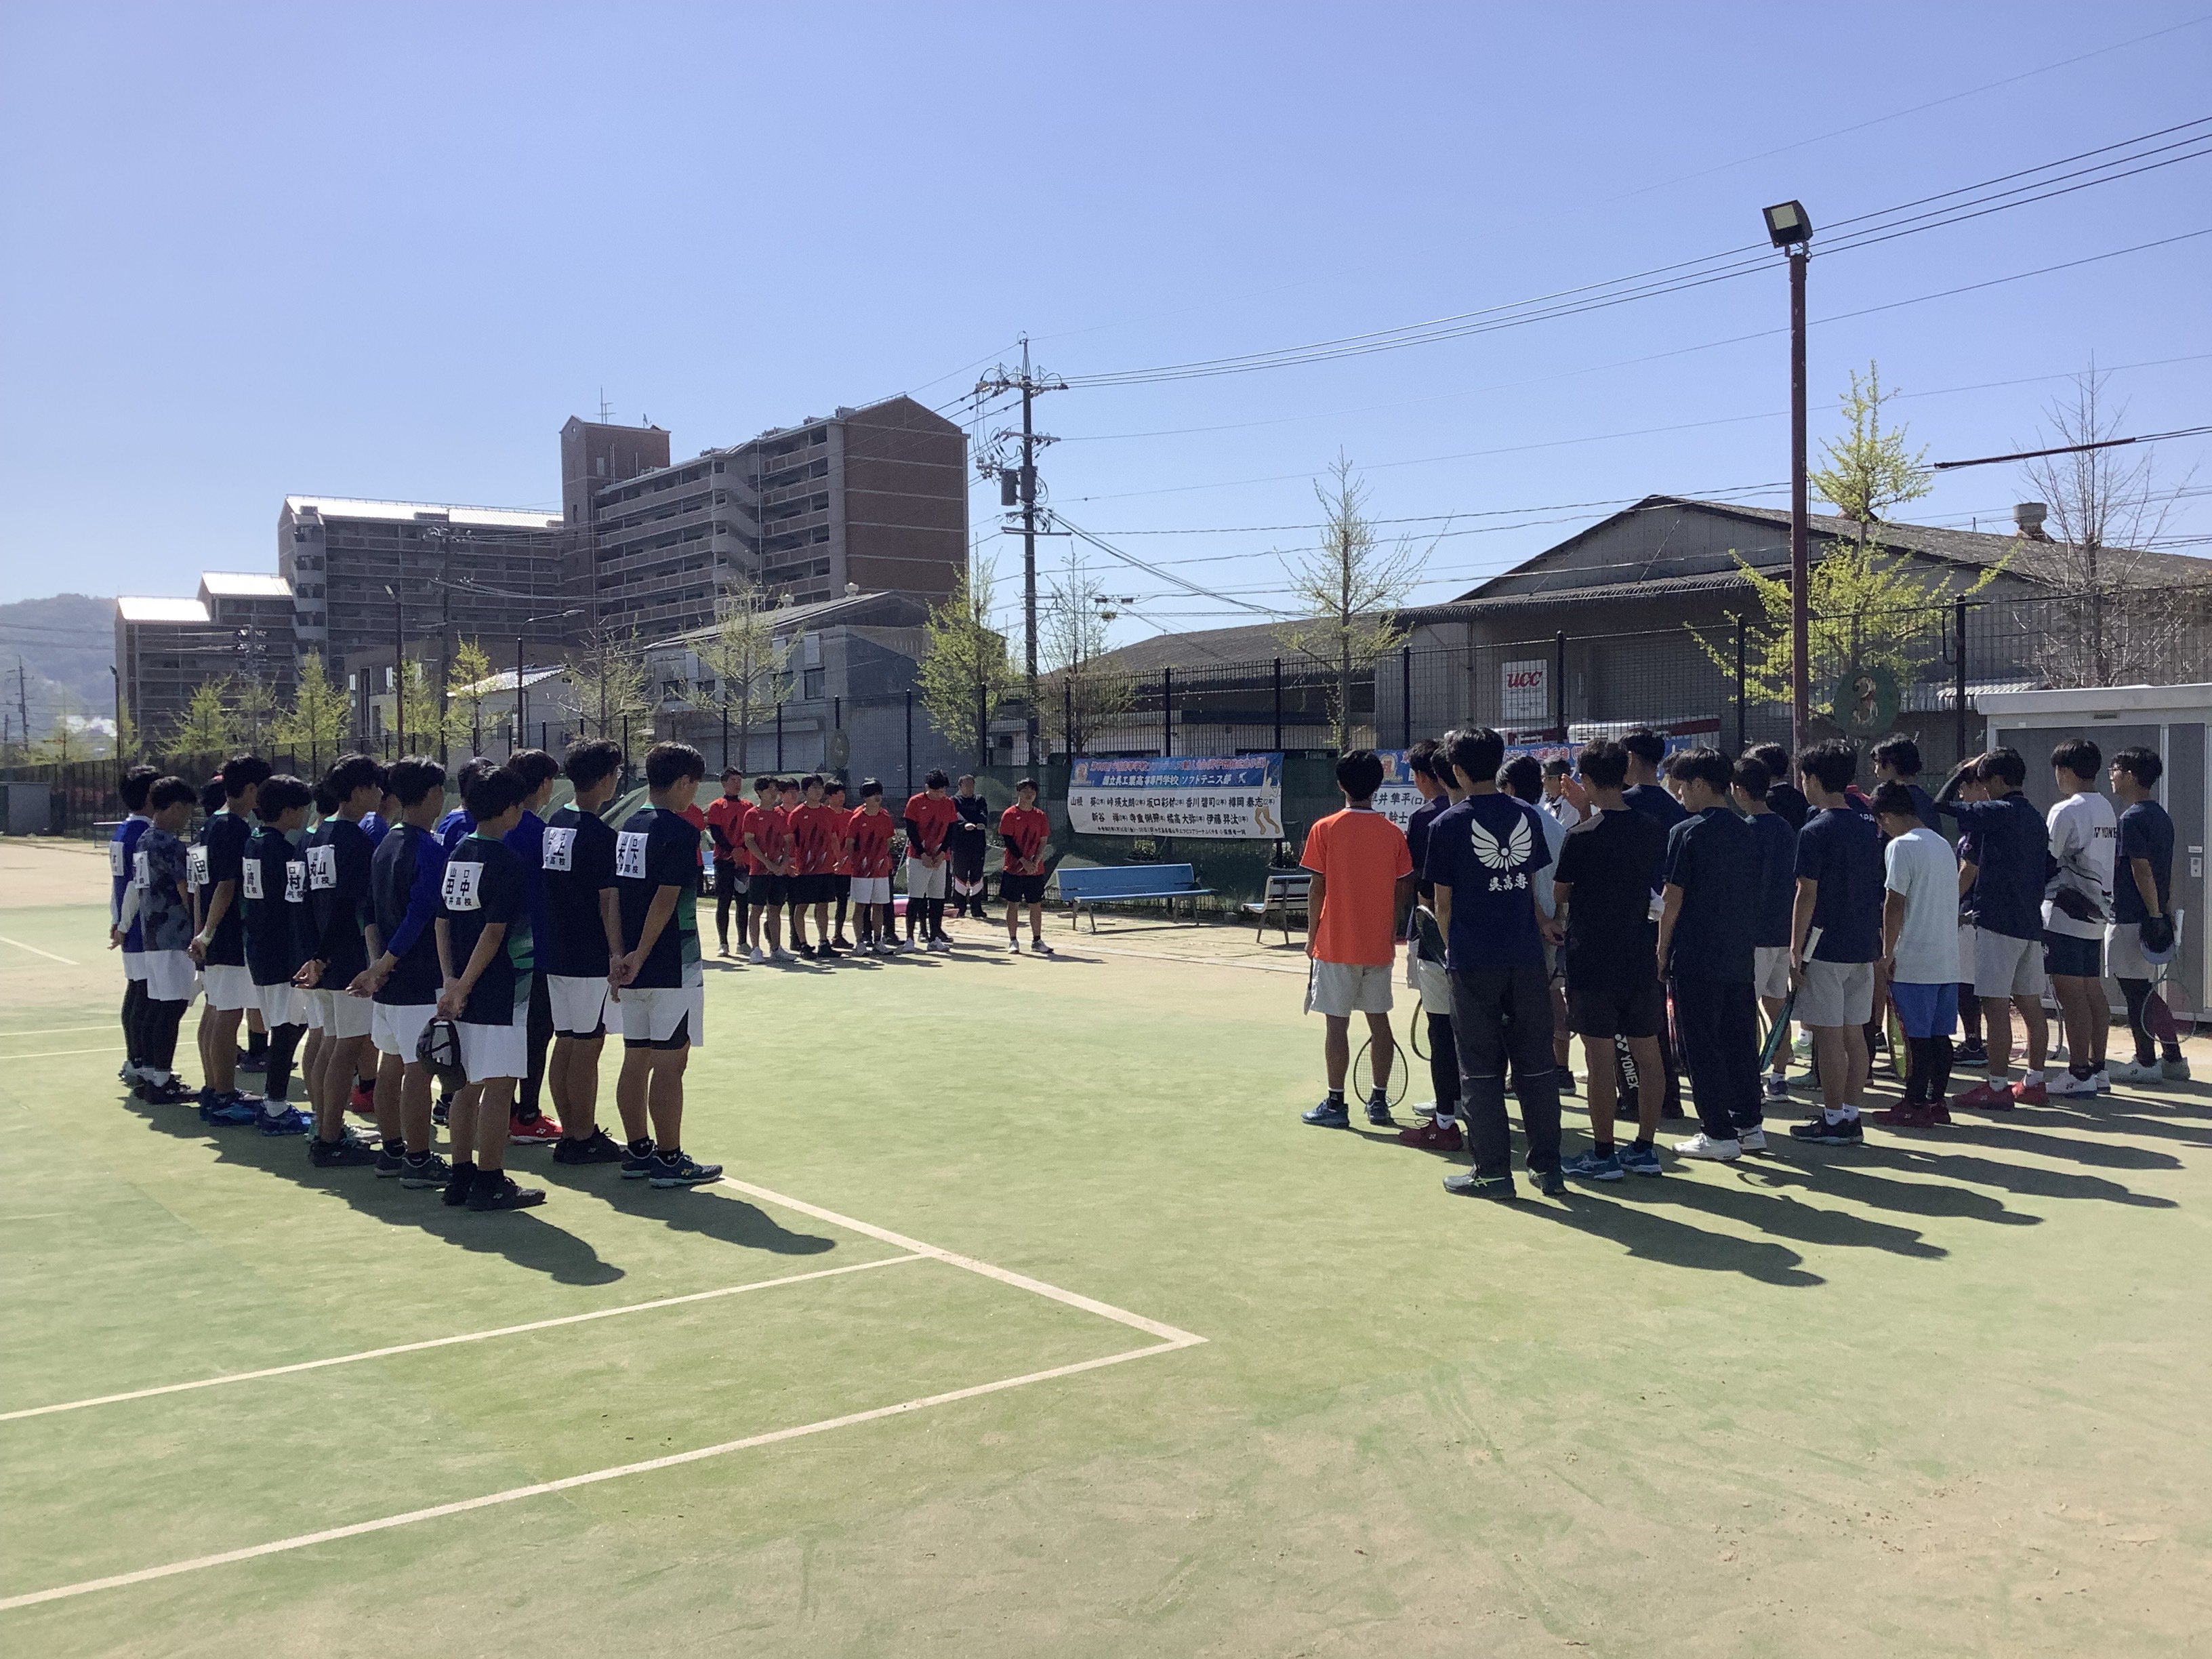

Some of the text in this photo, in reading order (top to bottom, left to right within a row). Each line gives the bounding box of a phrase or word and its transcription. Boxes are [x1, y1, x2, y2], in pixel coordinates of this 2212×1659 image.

[450, 868, 470, 878] 山口
[445, 878, 470, 897] 田中
[1620, 1054, 1640, 1089] YONEX
